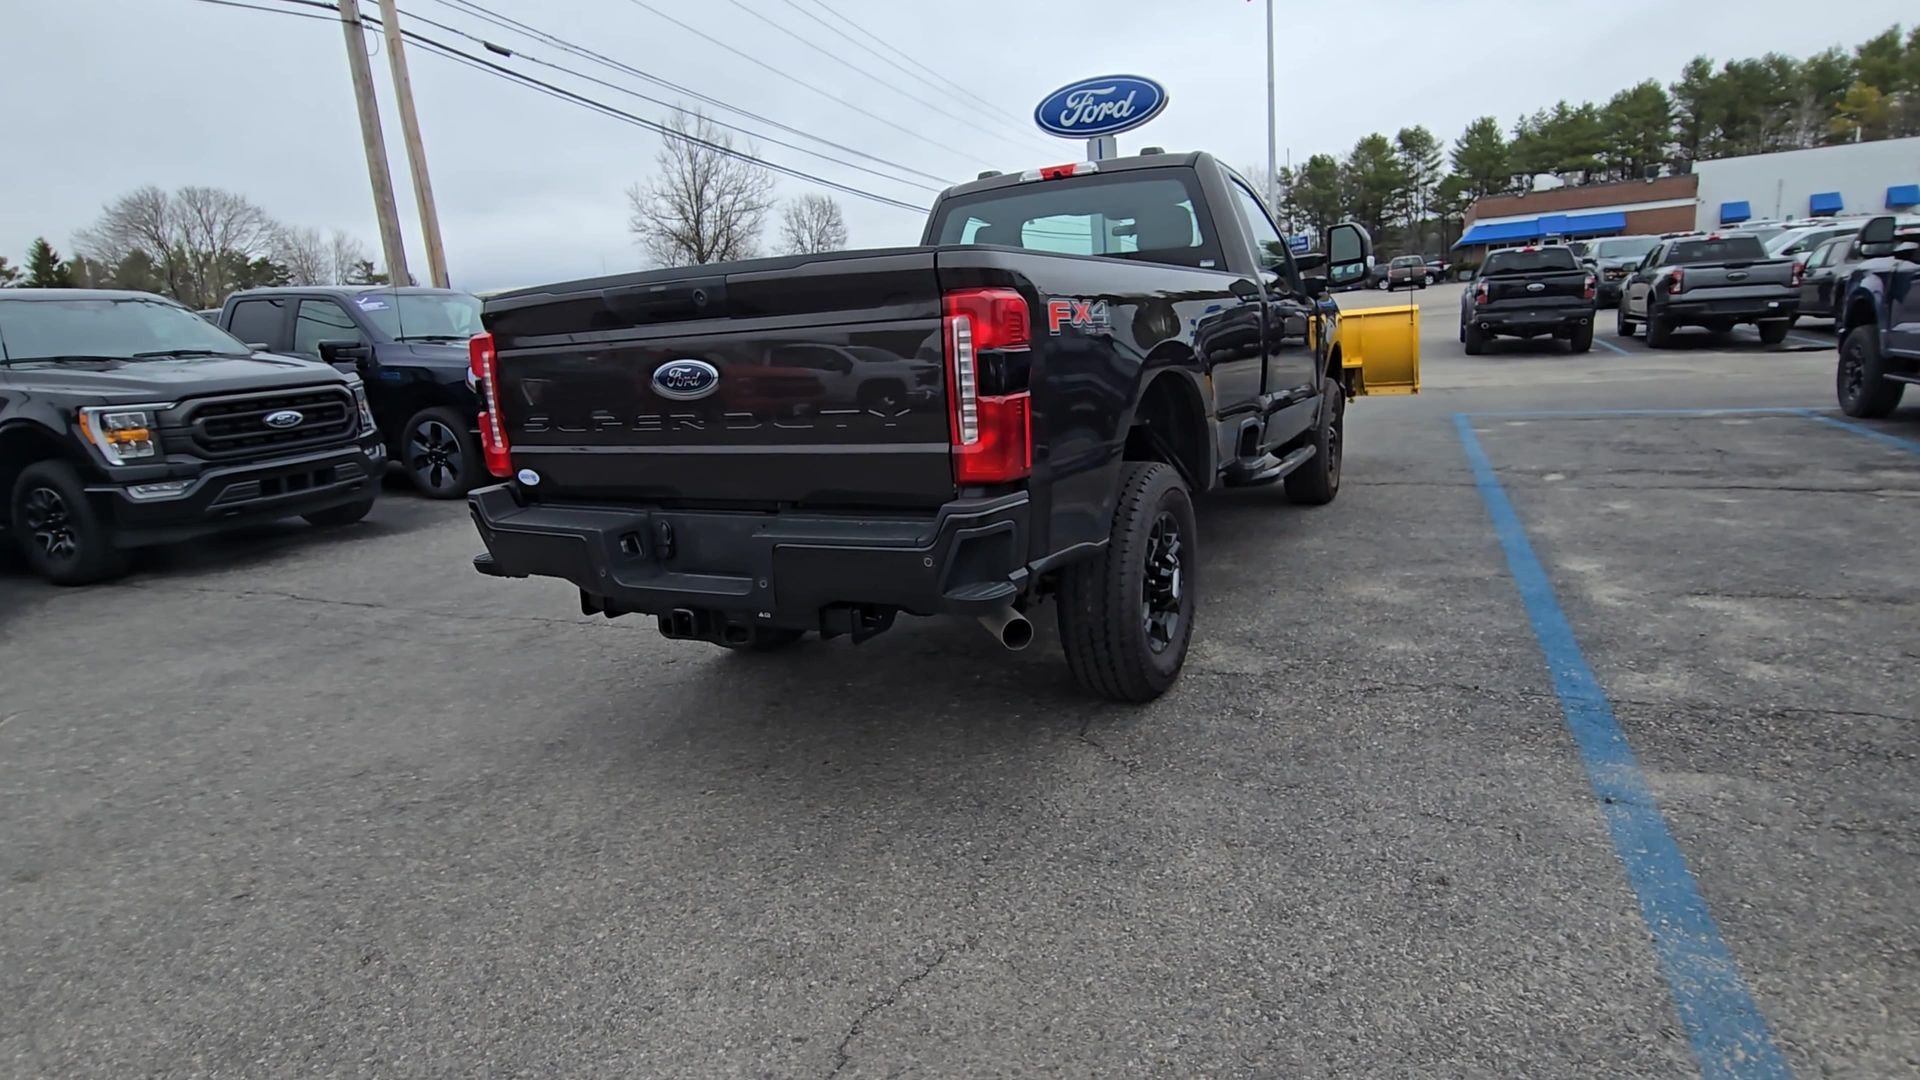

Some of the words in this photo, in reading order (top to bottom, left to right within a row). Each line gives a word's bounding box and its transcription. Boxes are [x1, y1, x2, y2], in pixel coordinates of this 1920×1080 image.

[1060, 86, 1136, 127] Ford
[1047, 298, 1111, 336] FX4
[667, 367, 701, 388] Ford
